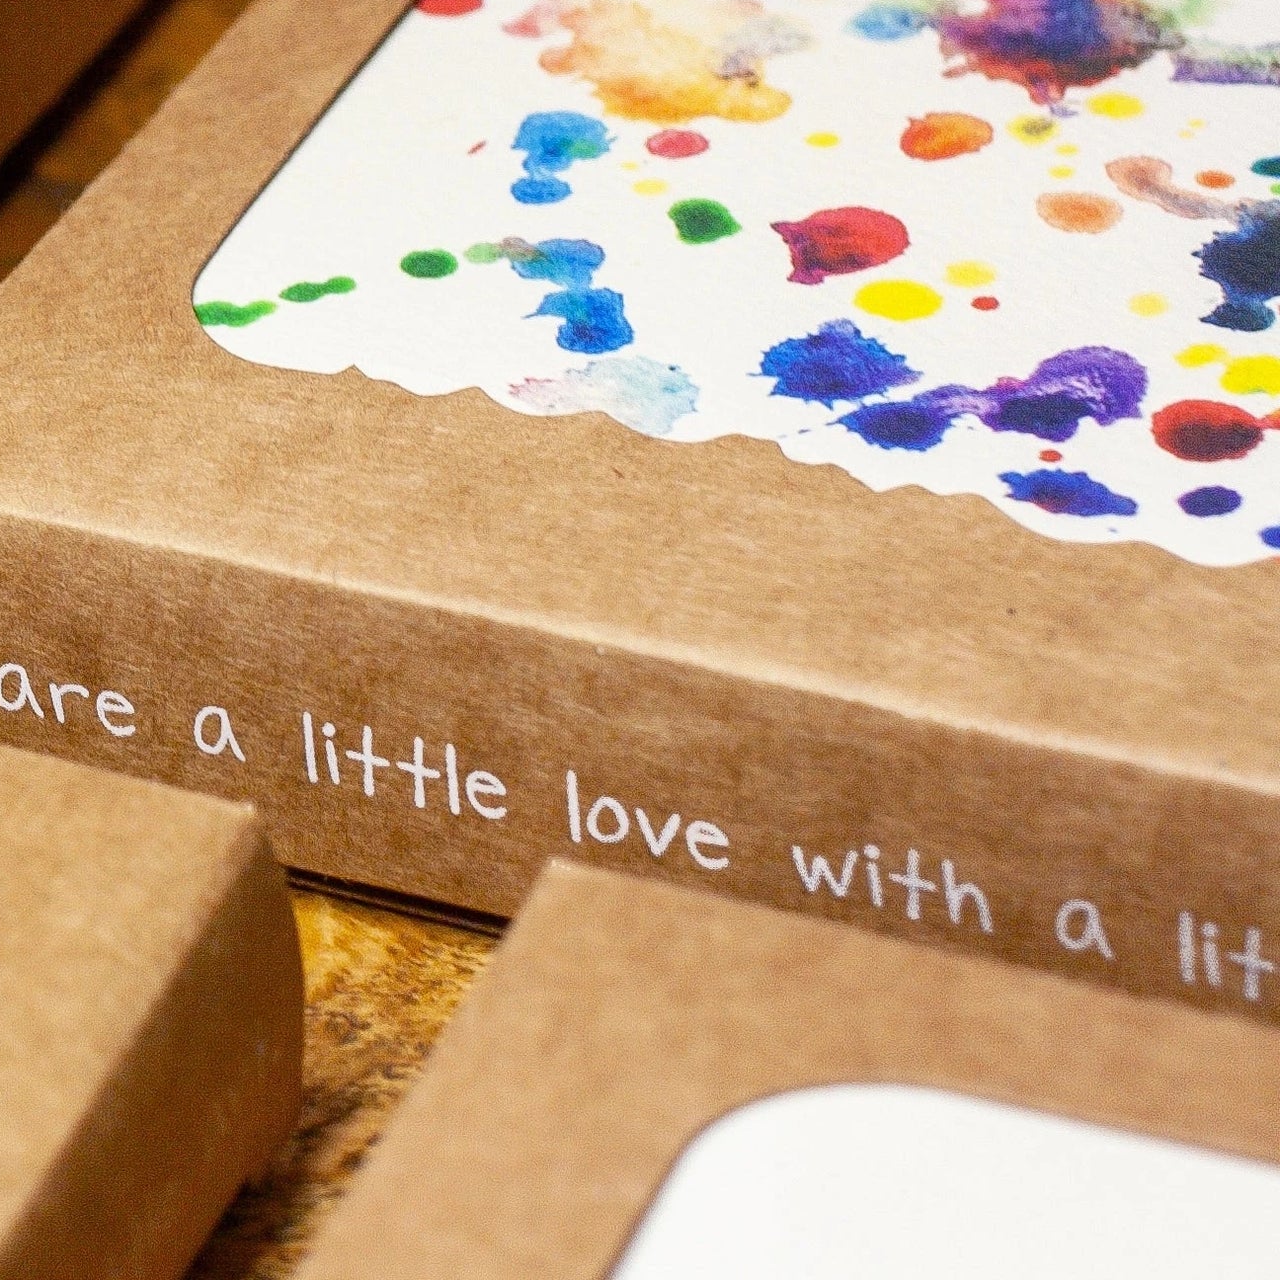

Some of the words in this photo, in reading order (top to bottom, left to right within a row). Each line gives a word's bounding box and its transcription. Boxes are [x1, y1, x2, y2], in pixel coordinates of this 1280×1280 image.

[194, 705, 247, 763] a
[302, 711, 509, 820] little
[566, 770, 730, 871] love
[792, 844, 994, 934] with
[1055, 899, 1115, 961] a
